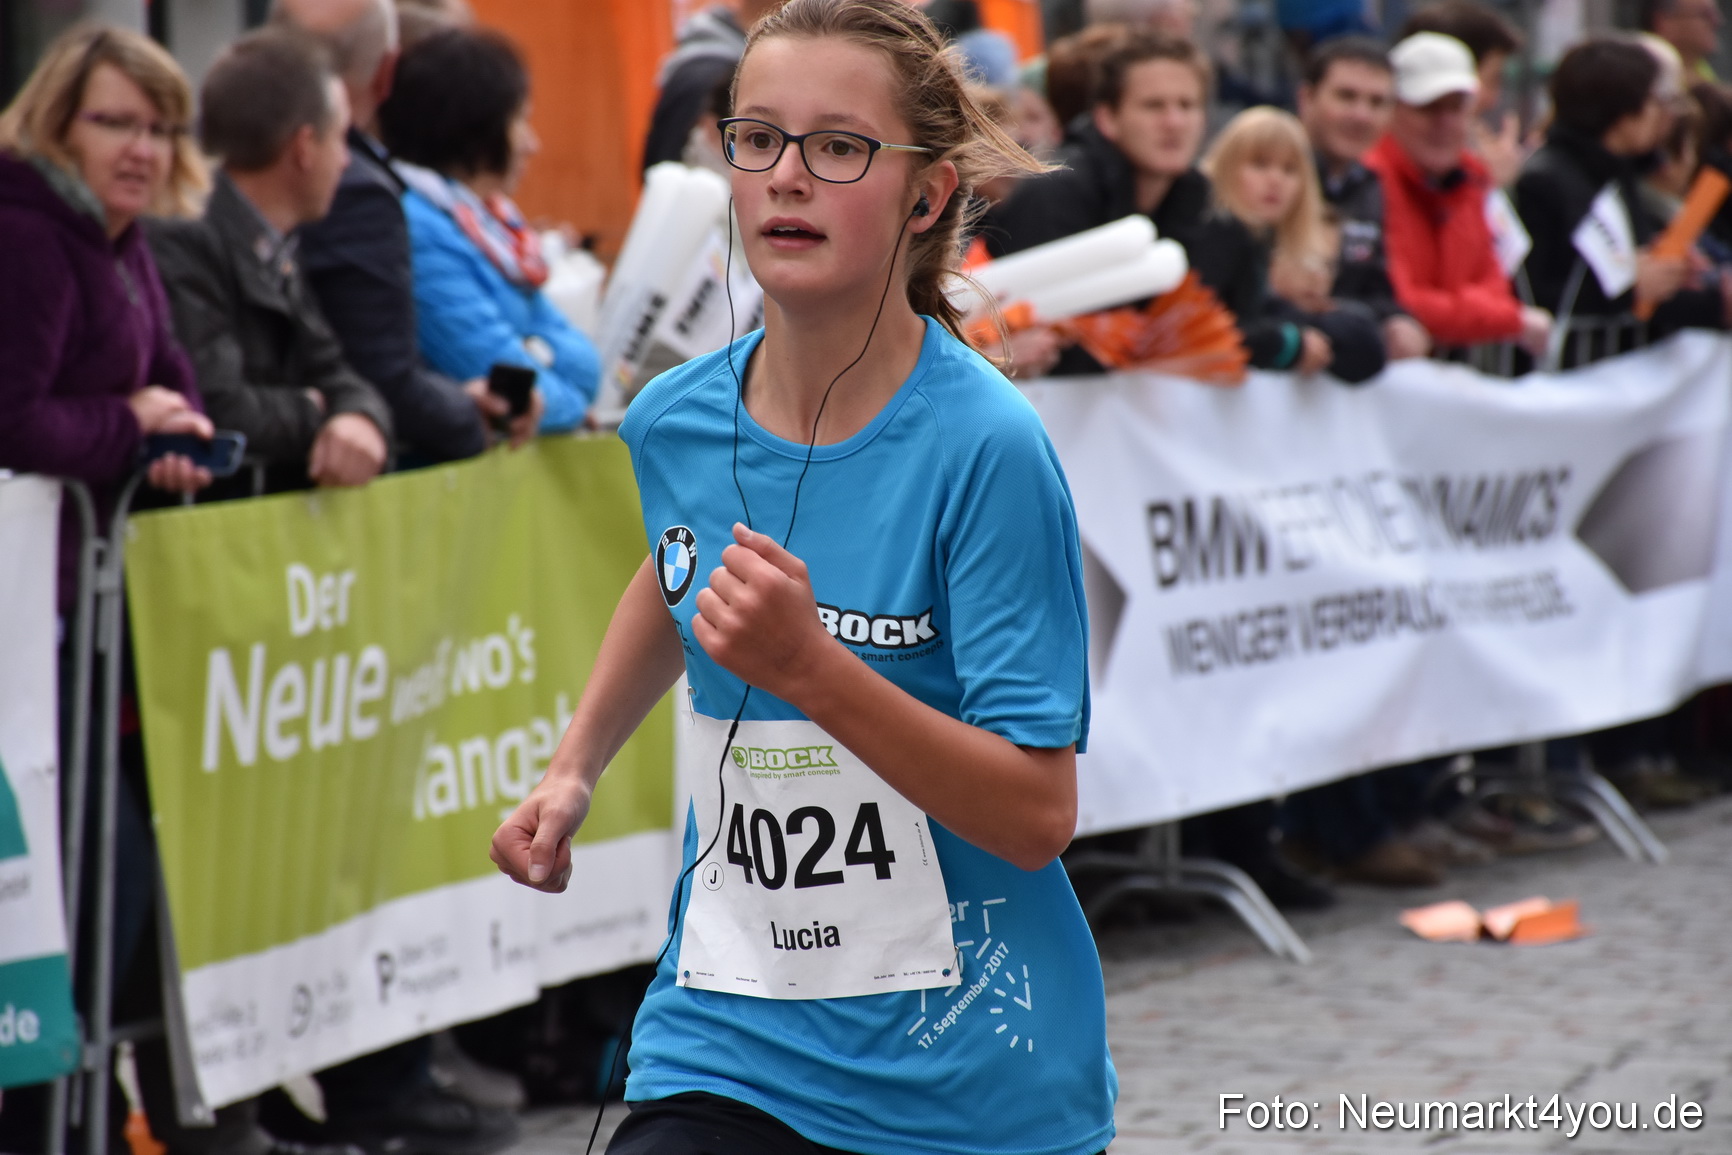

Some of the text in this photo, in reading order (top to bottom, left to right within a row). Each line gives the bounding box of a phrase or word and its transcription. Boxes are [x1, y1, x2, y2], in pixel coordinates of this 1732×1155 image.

[661, 528, 698, 559] BMW
[1147, 492, 1270, 589] BMW
[287, 563, 355, 637] Der
[815, 600, 940, 650] BOCK
[861, 650, 894, 663] smart
[897, 639, 945, 662] concepts
[202, 641, 387, 773] Neue
[748, 745, 838, 770] BOCK
[750, 768, 841, 780] inspired by smart concepts
[726, 802, 896, 891] 4024
[709, 869, 718, 885] J
[770, 920, 841, 951] Lucia
[917, 941, 1010, 1050] 17. September 2017
